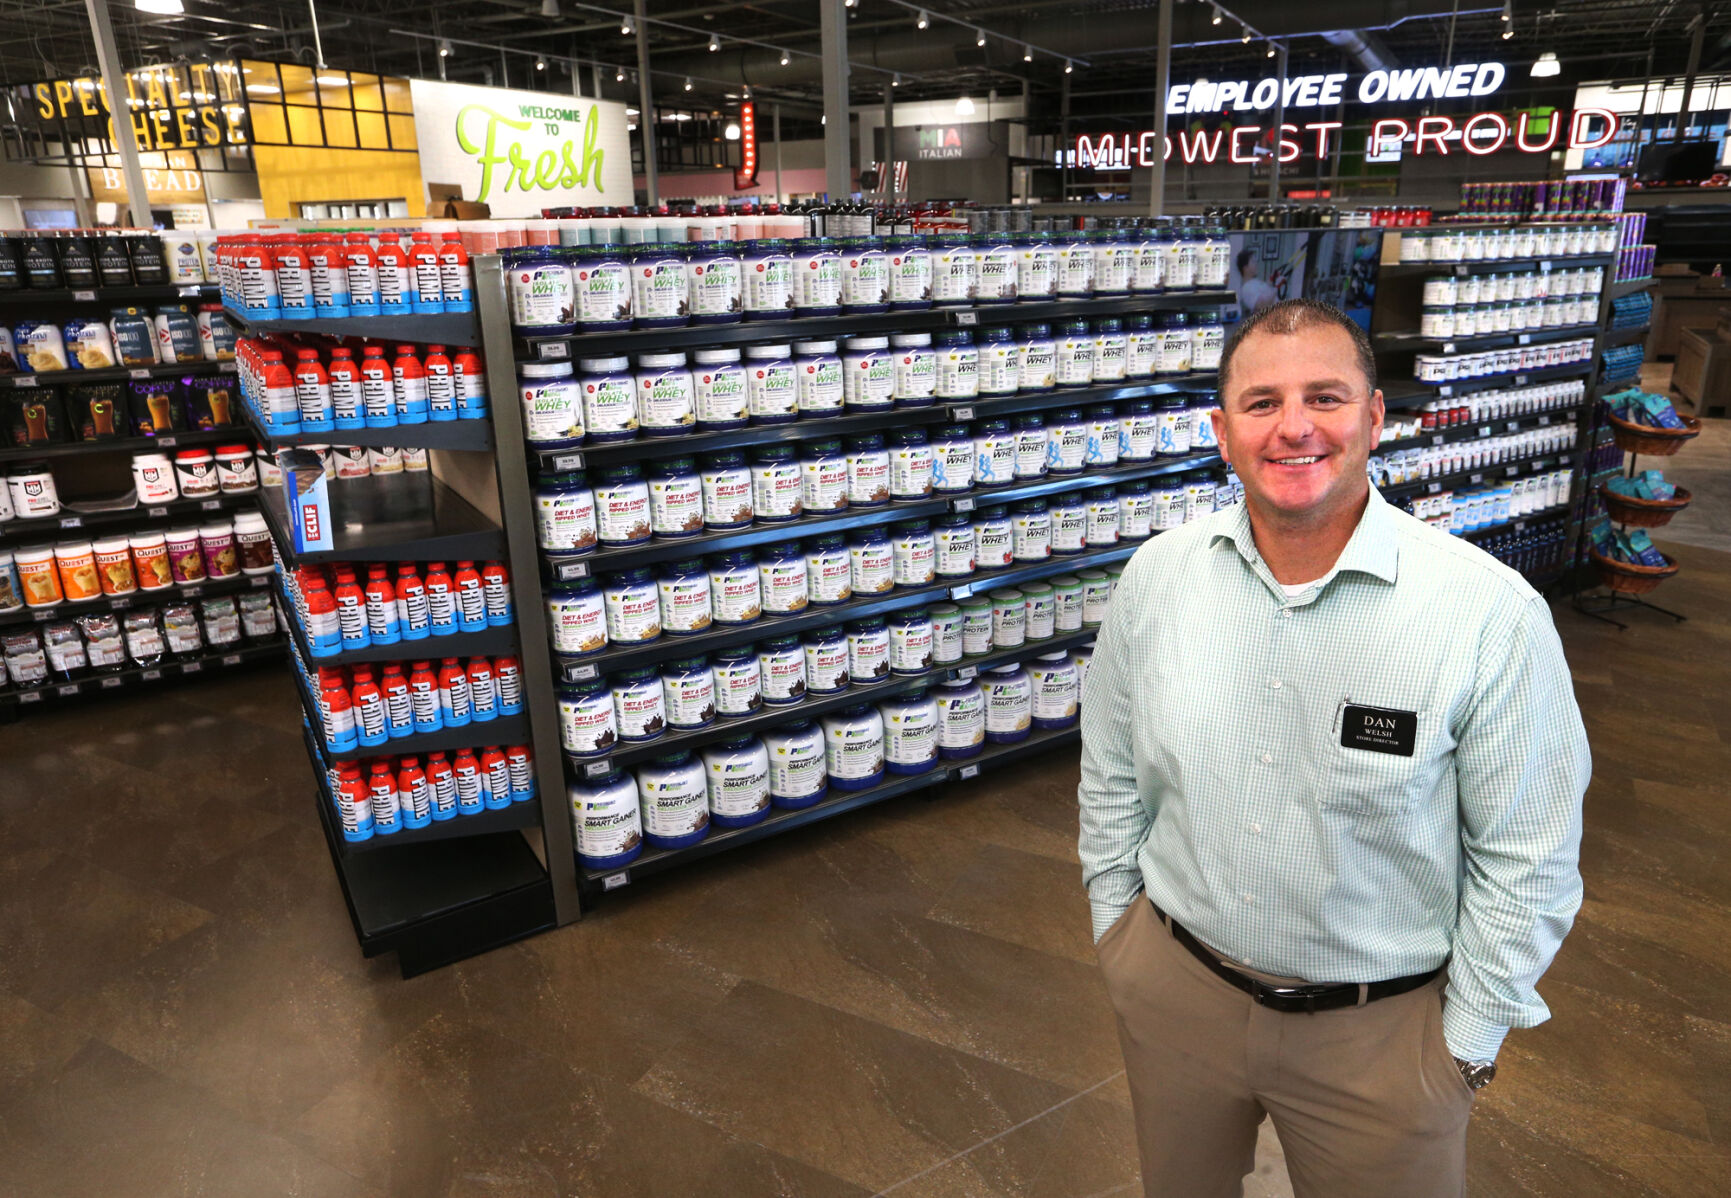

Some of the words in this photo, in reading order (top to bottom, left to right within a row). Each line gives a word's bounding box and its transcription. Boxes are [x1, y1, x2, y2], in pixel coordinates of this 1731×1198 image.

[1166, 74, 1347, 114] EMPLOYEE
[1359, 62, 1505, 103] OWNED
[519, 105, 580, 122] WELCOME
[544, 124, 559, 135] TO
[457, 104, 604, 203] Fresh
[919, 128, 962, 148] MIA
[919, 148, 962, 158] ITALIAN
[1076, 122, 1342, 167] MIDWEST
[1372, 108, 1618, 156] PROUD
[104, 168, 201, 191] BEAD
[240, 257, 268, 308] PRIME
[277, 256, 306, 307] PRIME
[310, 256, 332, 306] PRIME
[347, 255, 373, 304] PRIME
[378, 256, 401, 304] PRIME
[417, 254, 440, 302] PRIME
[440, 254, 462, 301] PRIME
[532, 284, 567, 294] WHEY
[590, 281, 624, 291] WHEY
[654, 278, 686, 288] WHEY
[705, 276, 736, 285] WHEY
[298, 373, 324, 421] PRIME
[331, 371, 356, 418] PRIME
[364, 369, 388, 416] PRIME
[428, 365, 450, 411] PRIME
[535, 400, 570, 410] WHEY
[597, 394, 630, 403] WHEY
[653, 389, 686, 399] WHEY
[712, 384, 744, 394] WHEY
[242, 534, 262, 542] QUEST
[305, 507, 317, 532] CLIF
[97, 554, 118, 562] QUEST
[138, 547, 162, 557] QUEST
[168, 543, 188, 551] QUEST
[204, 537, 226, 546] QUEST
[367, 592, 387, 635] PRIME
[406, 586, 427, 630] PRIME
[429, 584, 451, 626] PRIME
[462, 579, 485, 623] PRIME
[485, 575, 506, 616] PRIME
[339, 596, 363, 639] PRIME
[943, 633, 961, 641] PROTE
[413, 682, 435, 723] PRIME
[450, 674, 469, 718] PRIME
[472, 671, 494, 712] PRIME
[500, 666, 520, 706] PRIME
[360, 692, 384, 737] PRIME
[389, 685, 411, 728] PRIME
[1364, 716, 1396, 729] DAN
[844, 744, 866, 752] SMART
[902, 729, 924, 737] SMART
[1365, 729, 1392, 737] WELSH
[490, 760, 509, 800] PRIME
[510, 755, 530, 792] PRIME
[788, 761, 812, 770] SMART
[372, 785, 395, 825] PRIME
[412, 776, 429, 820] PRIME
[436, 770, 455, 812] PRIME
[457, 766, 478, 806] PRIME
[339, 792, 358, 832] PRIME
[585, 819, 612, 827] SMART
